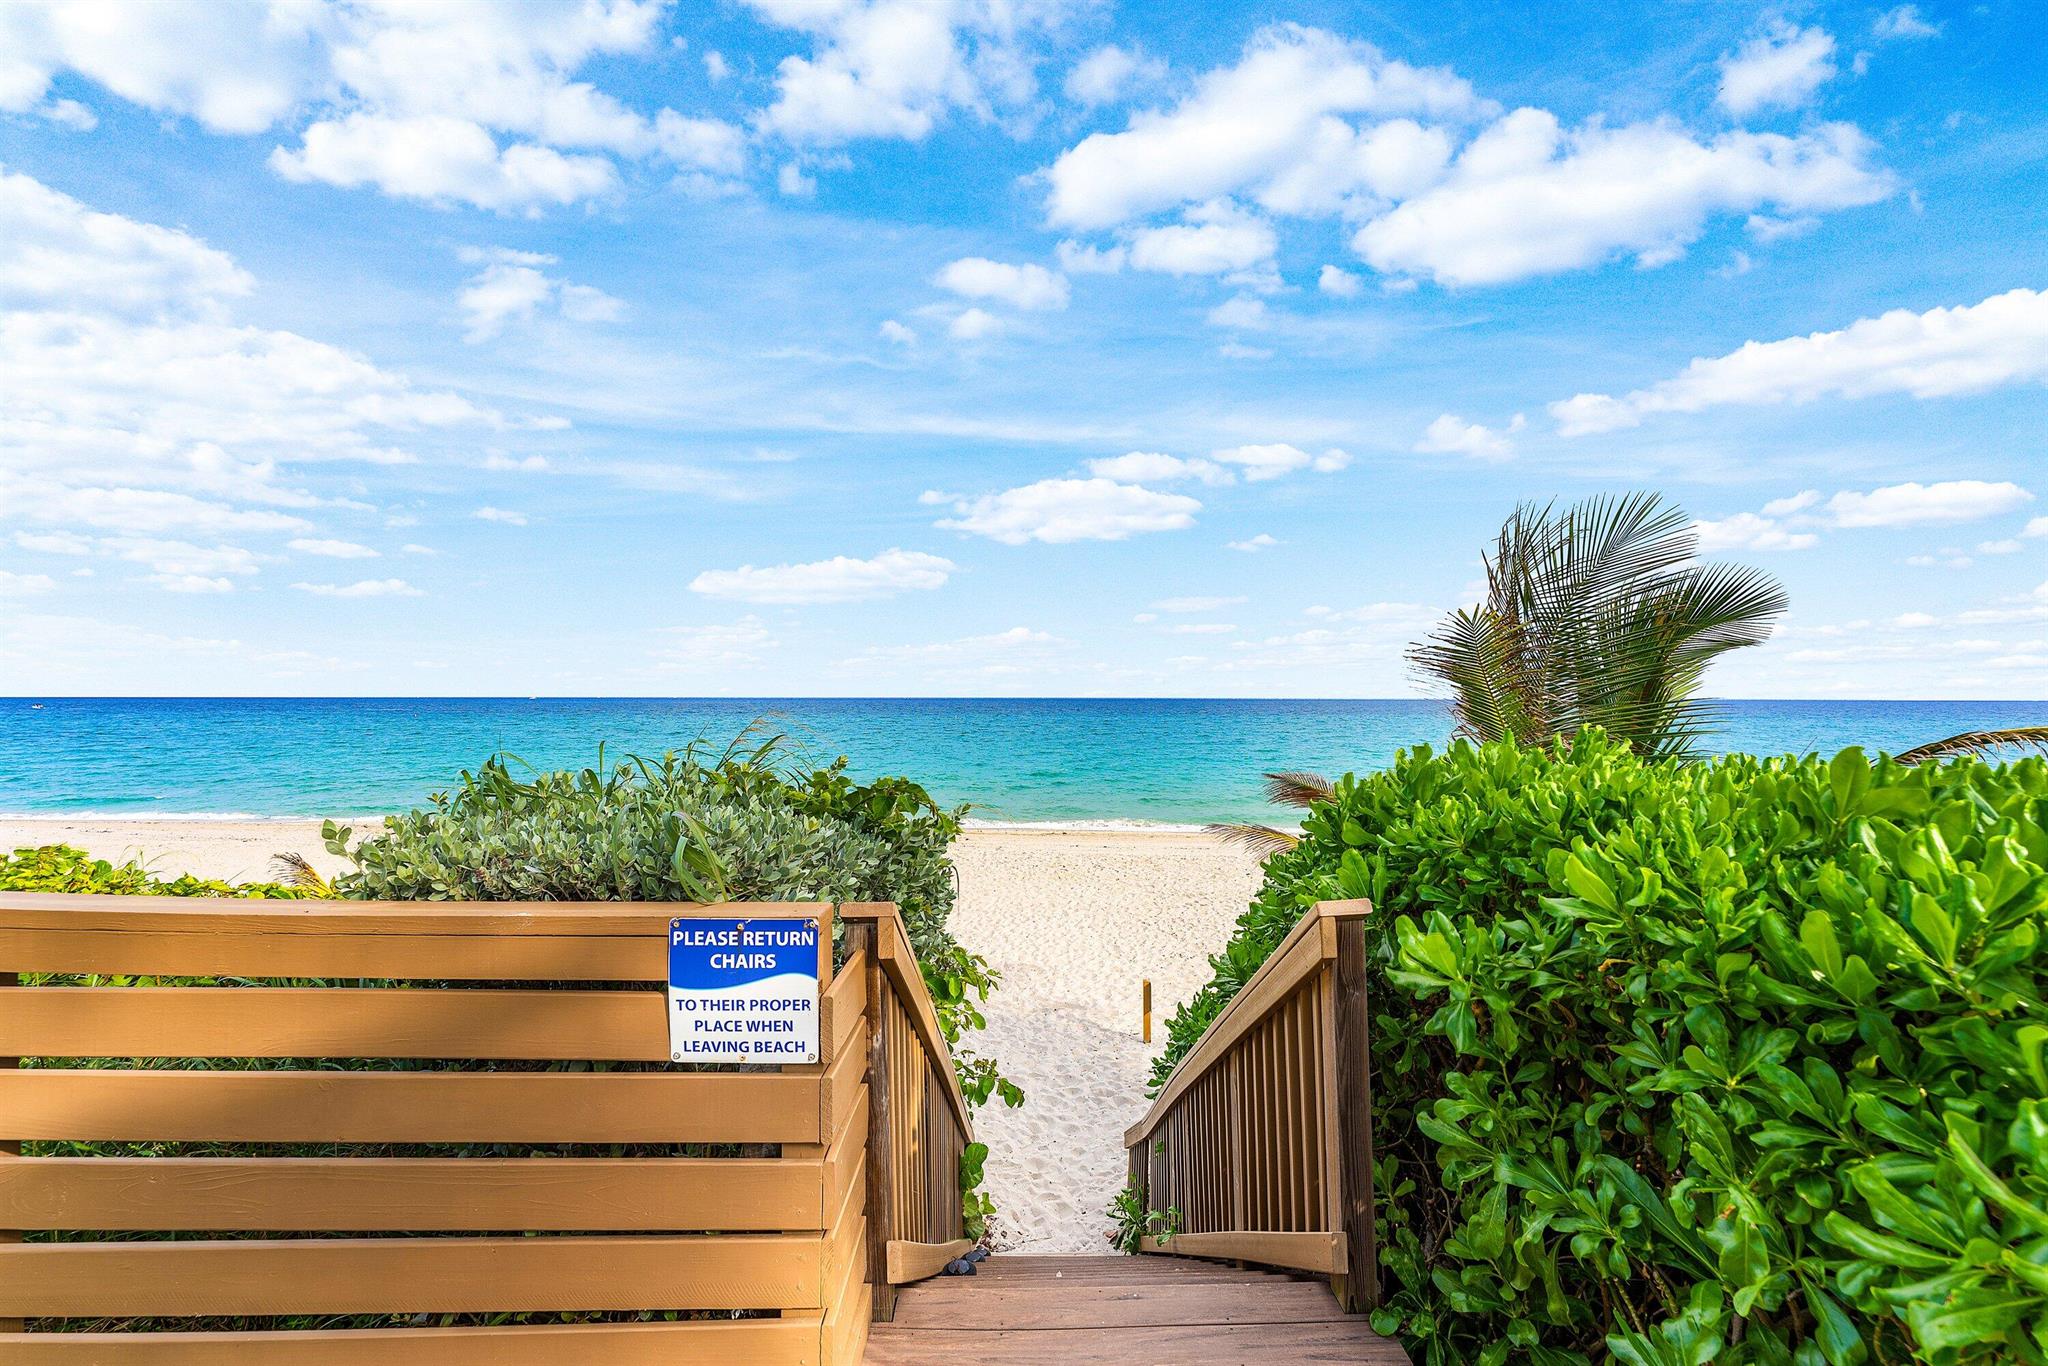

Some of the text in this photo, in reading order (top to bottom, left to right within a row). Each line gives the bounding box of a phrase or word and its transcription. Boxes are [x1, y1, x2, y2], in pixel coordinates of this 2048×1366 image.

[673, 931, 815, 946] PLEASE RETURN
[709, 953, 777, 969] CHAIRS
[675, 999, 811, 1011] TO THEIR PROPER
[694, 1020, 794, 1032] PLACE WHEN
[683, 1040, 806, 1053] LEAVING BEACH
